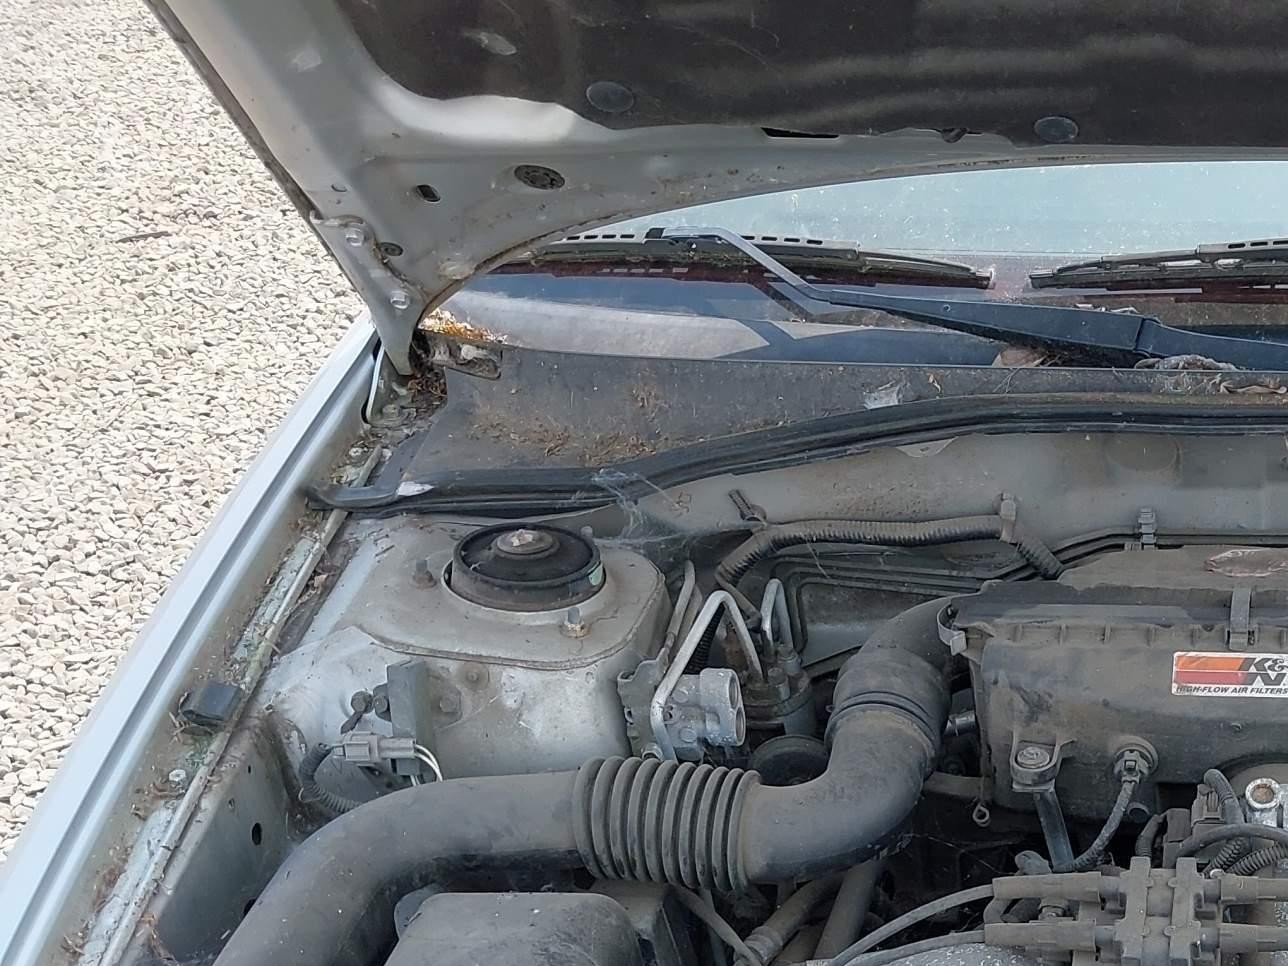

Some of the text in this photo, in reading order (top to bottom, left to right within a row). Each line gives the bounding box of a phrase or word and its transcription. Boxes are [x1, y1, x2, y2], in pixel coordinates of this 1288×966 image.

[1176, 685, 1288, 695] HIGH-FLOW AIR FILTERS
